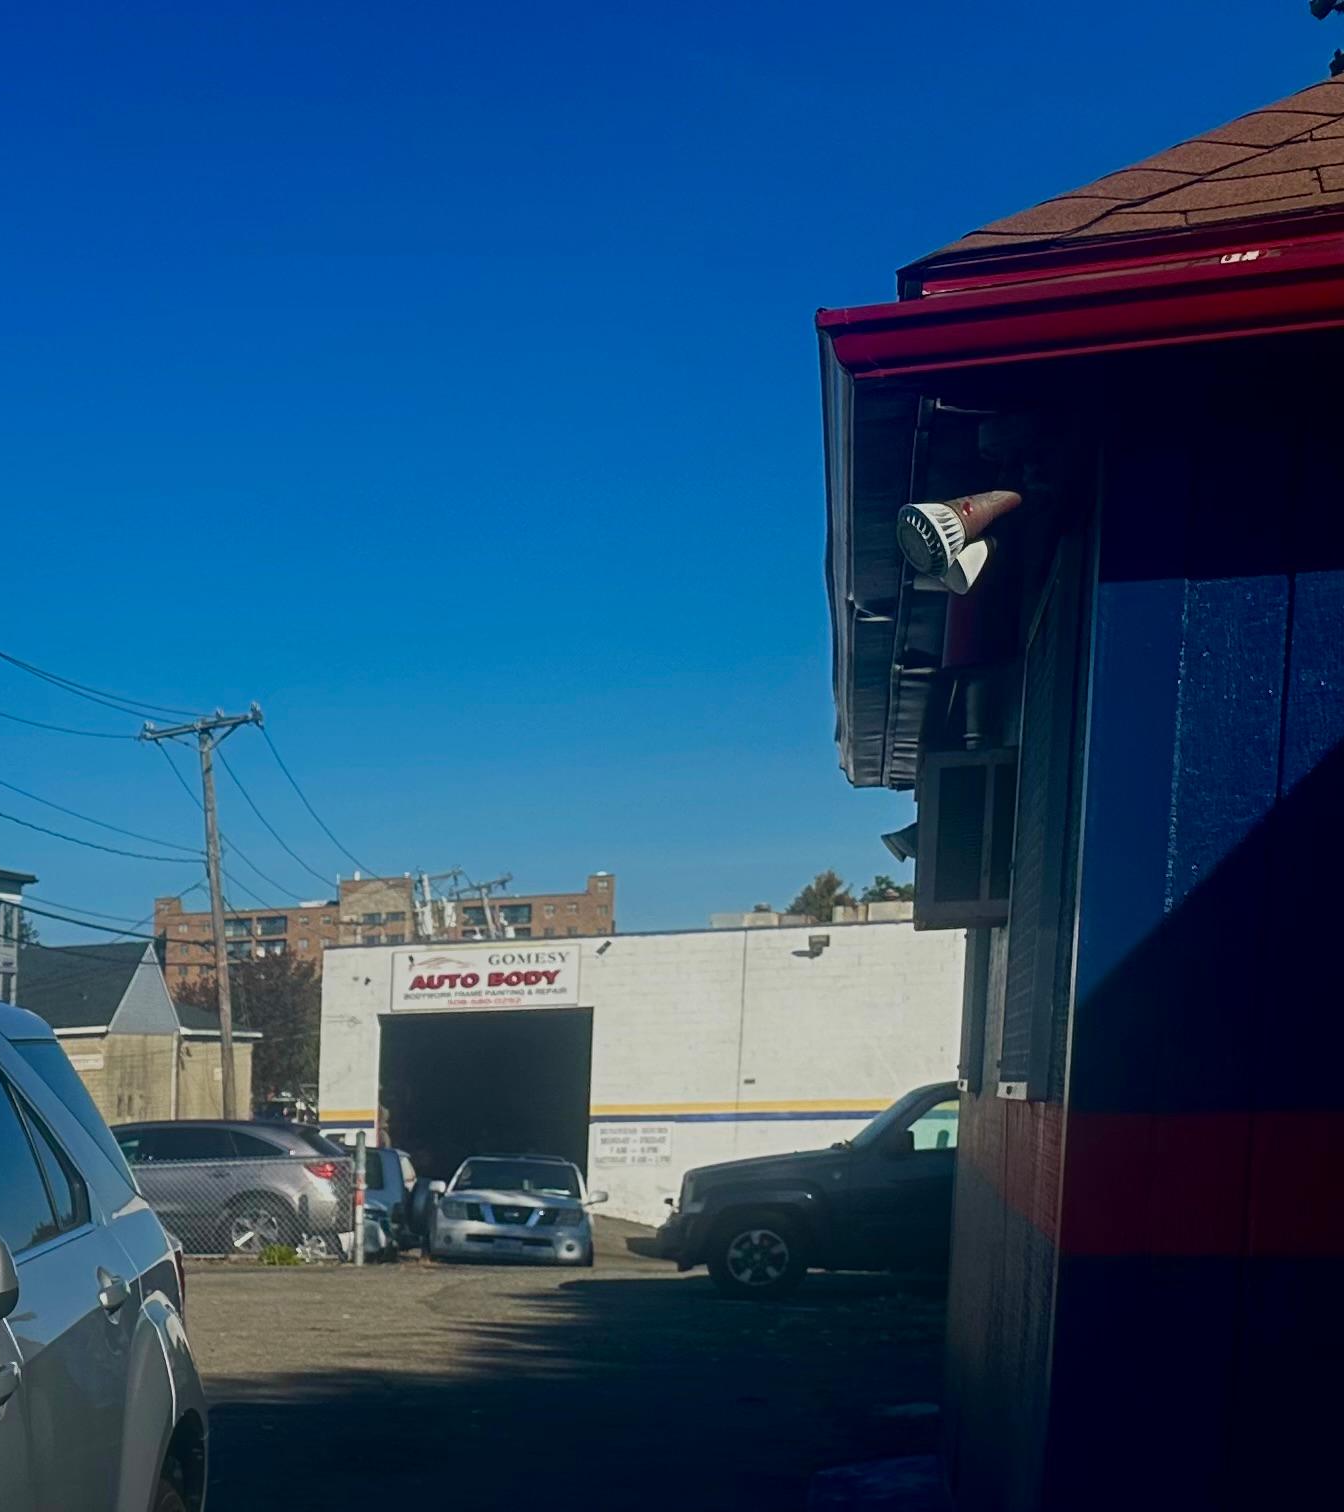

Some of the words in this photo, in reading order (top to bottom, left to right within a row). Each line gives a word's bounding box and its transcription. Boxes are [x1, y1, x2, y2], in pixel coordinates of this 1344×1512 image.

[488, 951, 571, 966] GOMESY
[409, 972, 480, 991] AUTO
[487, 969, 561, 987] BODY
